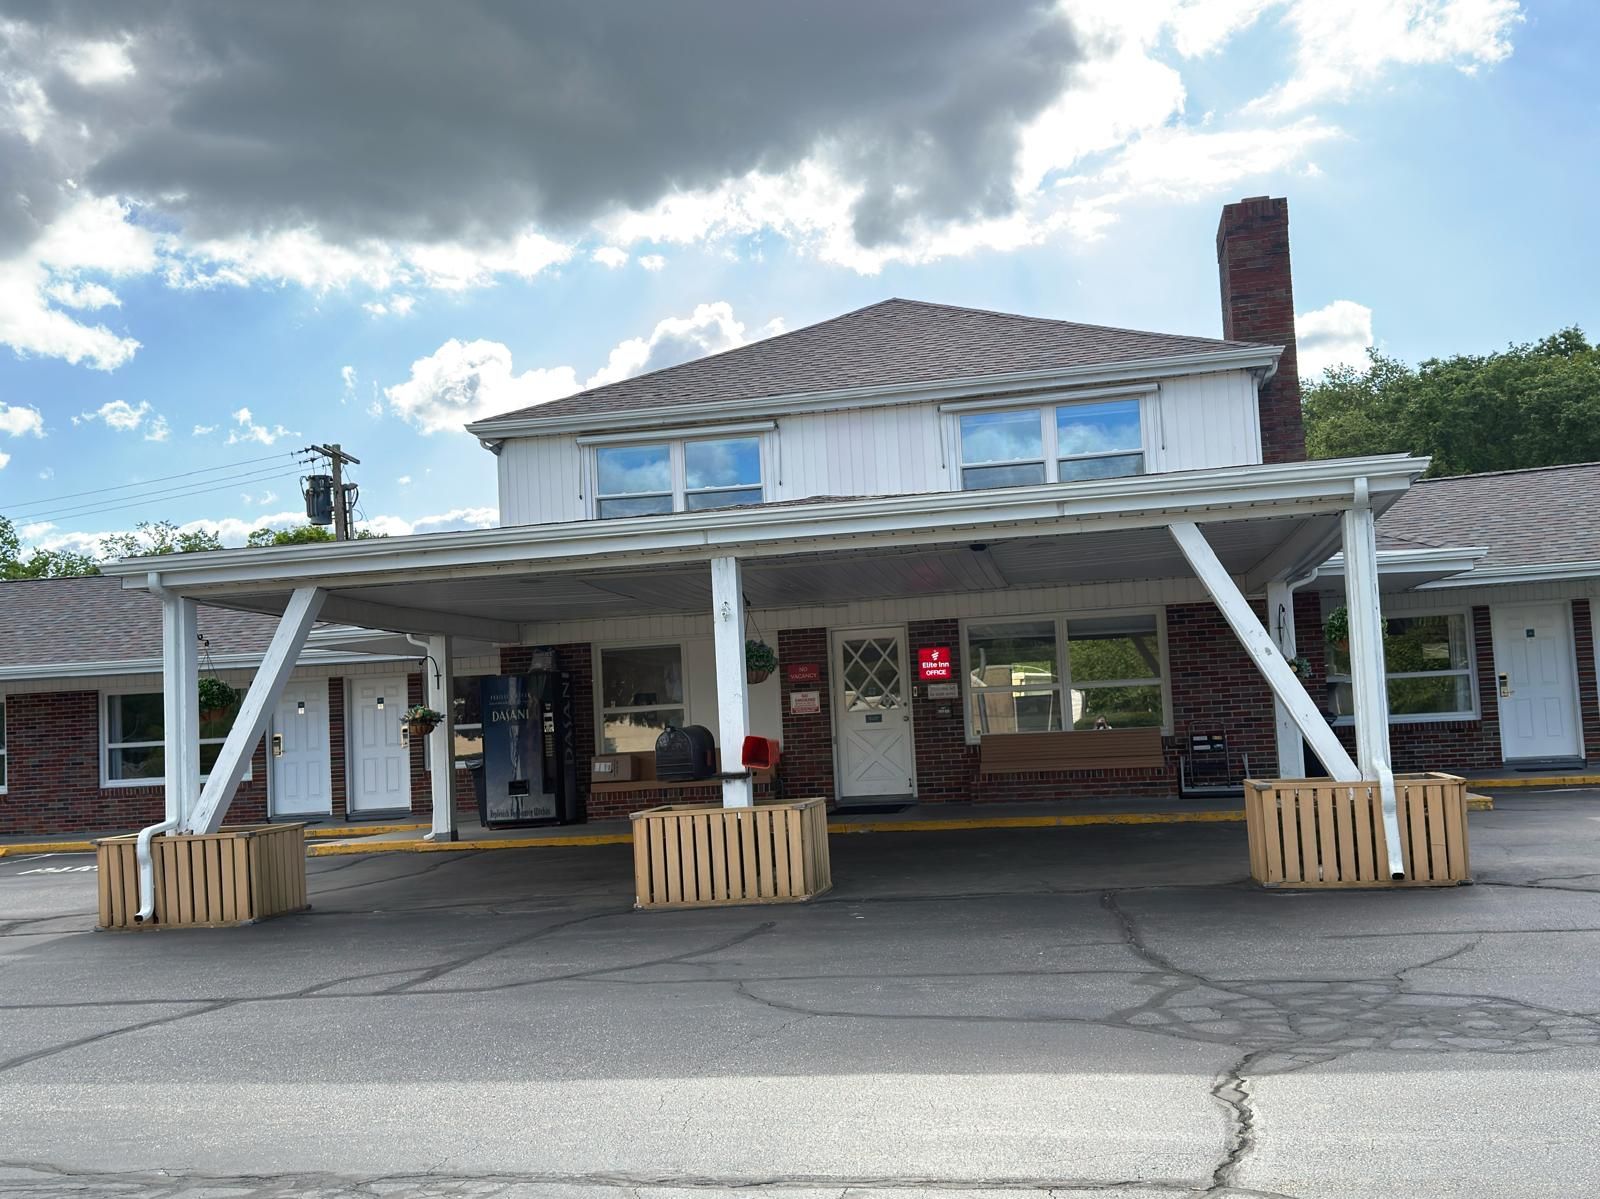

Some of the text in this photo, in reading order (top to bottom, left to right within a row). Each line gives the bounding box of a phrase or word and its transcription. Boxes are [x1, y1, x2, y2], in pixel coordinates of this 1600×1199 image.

[922, 660, 950, 669] Elite Inn
[492, 708, 529, 722] DASANI
[561, 672, 574, 765] DASANI
